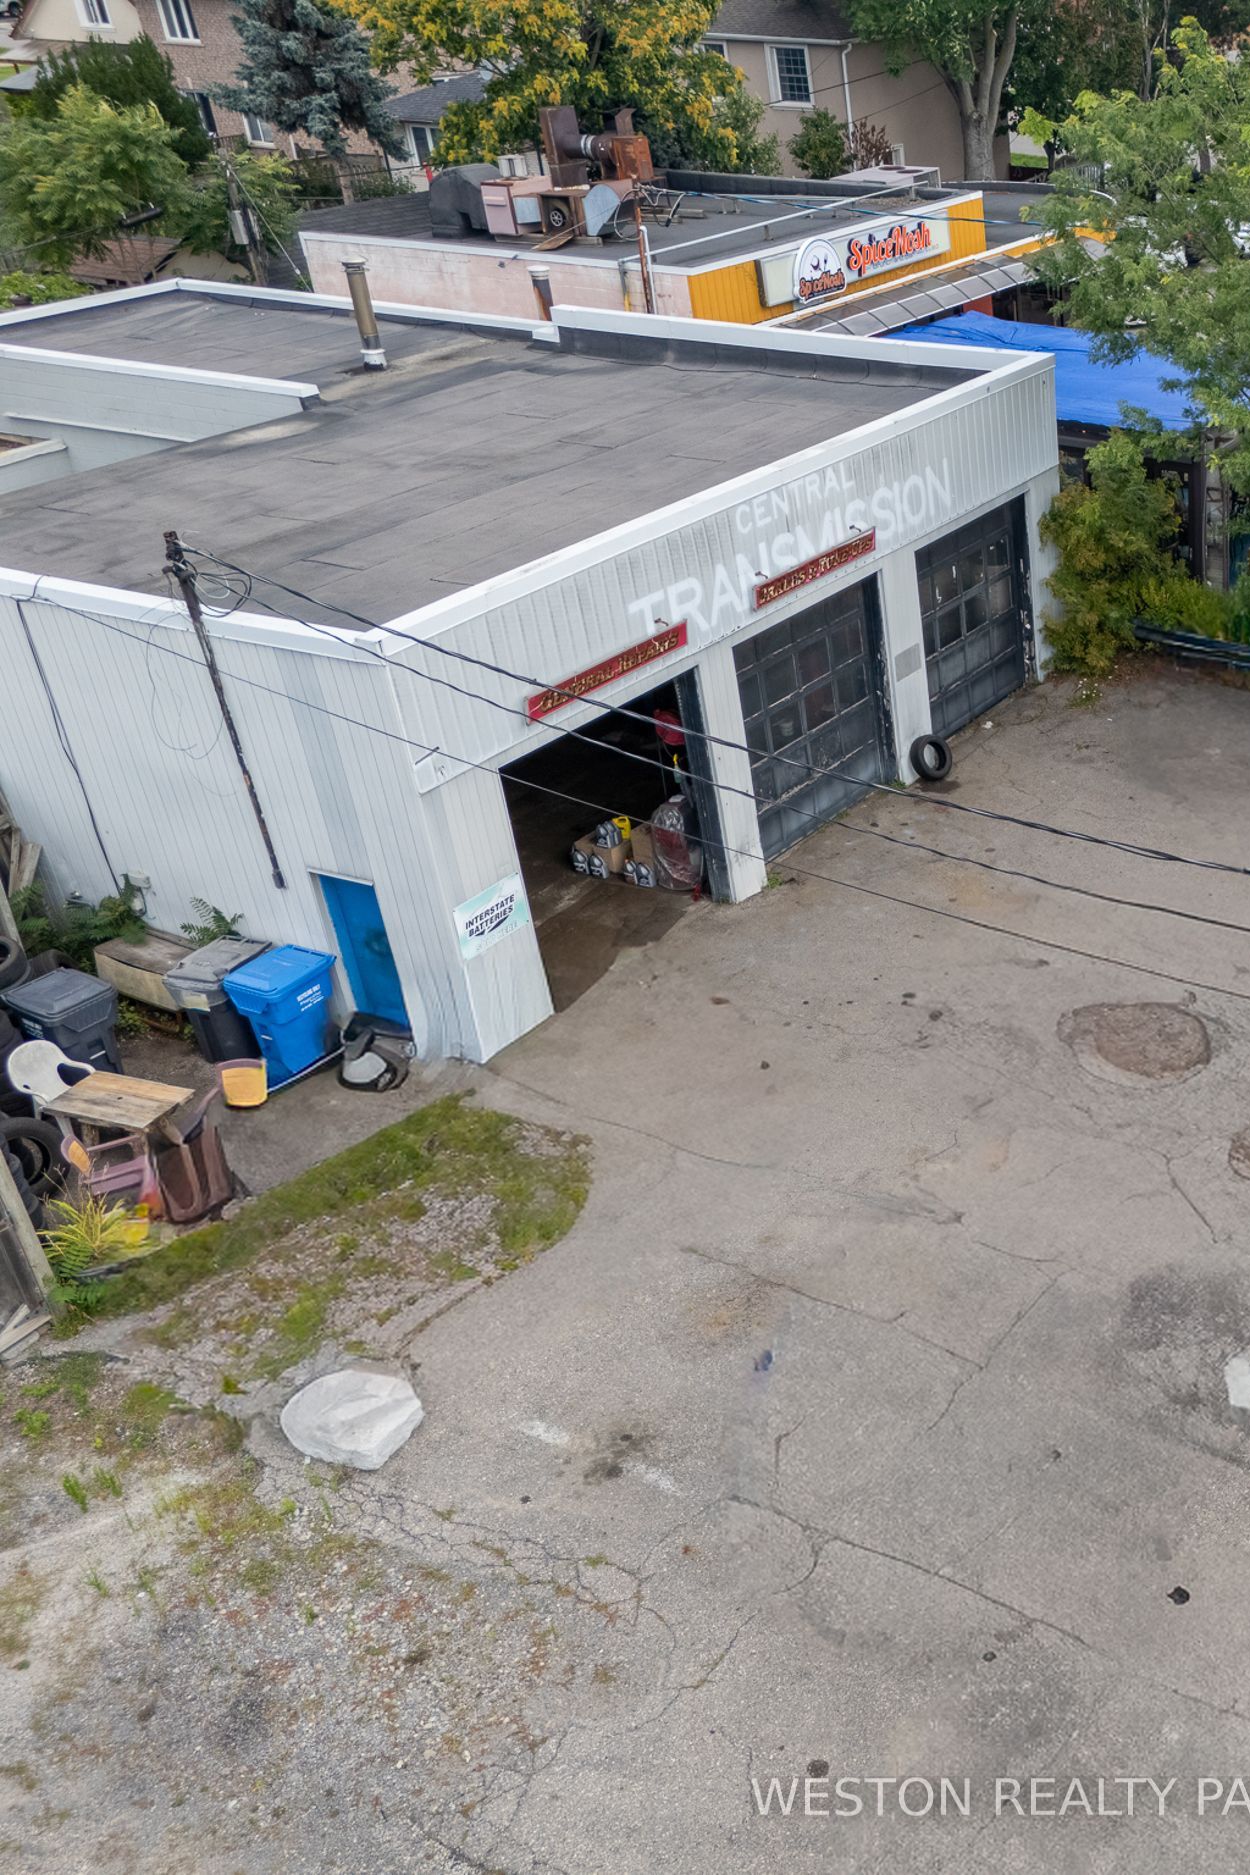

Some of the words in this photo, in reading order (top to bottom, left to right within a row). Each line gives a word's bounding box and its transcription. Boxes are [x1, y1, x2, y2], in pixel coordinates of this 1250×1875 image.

[735, 465, 855, 534] CENTRAL
[627, 458, 951, 636] TRANSMISSION
[465, 893, 515, 930] INTERSTATE
[469, 904, 514, 937] BATTERIES
